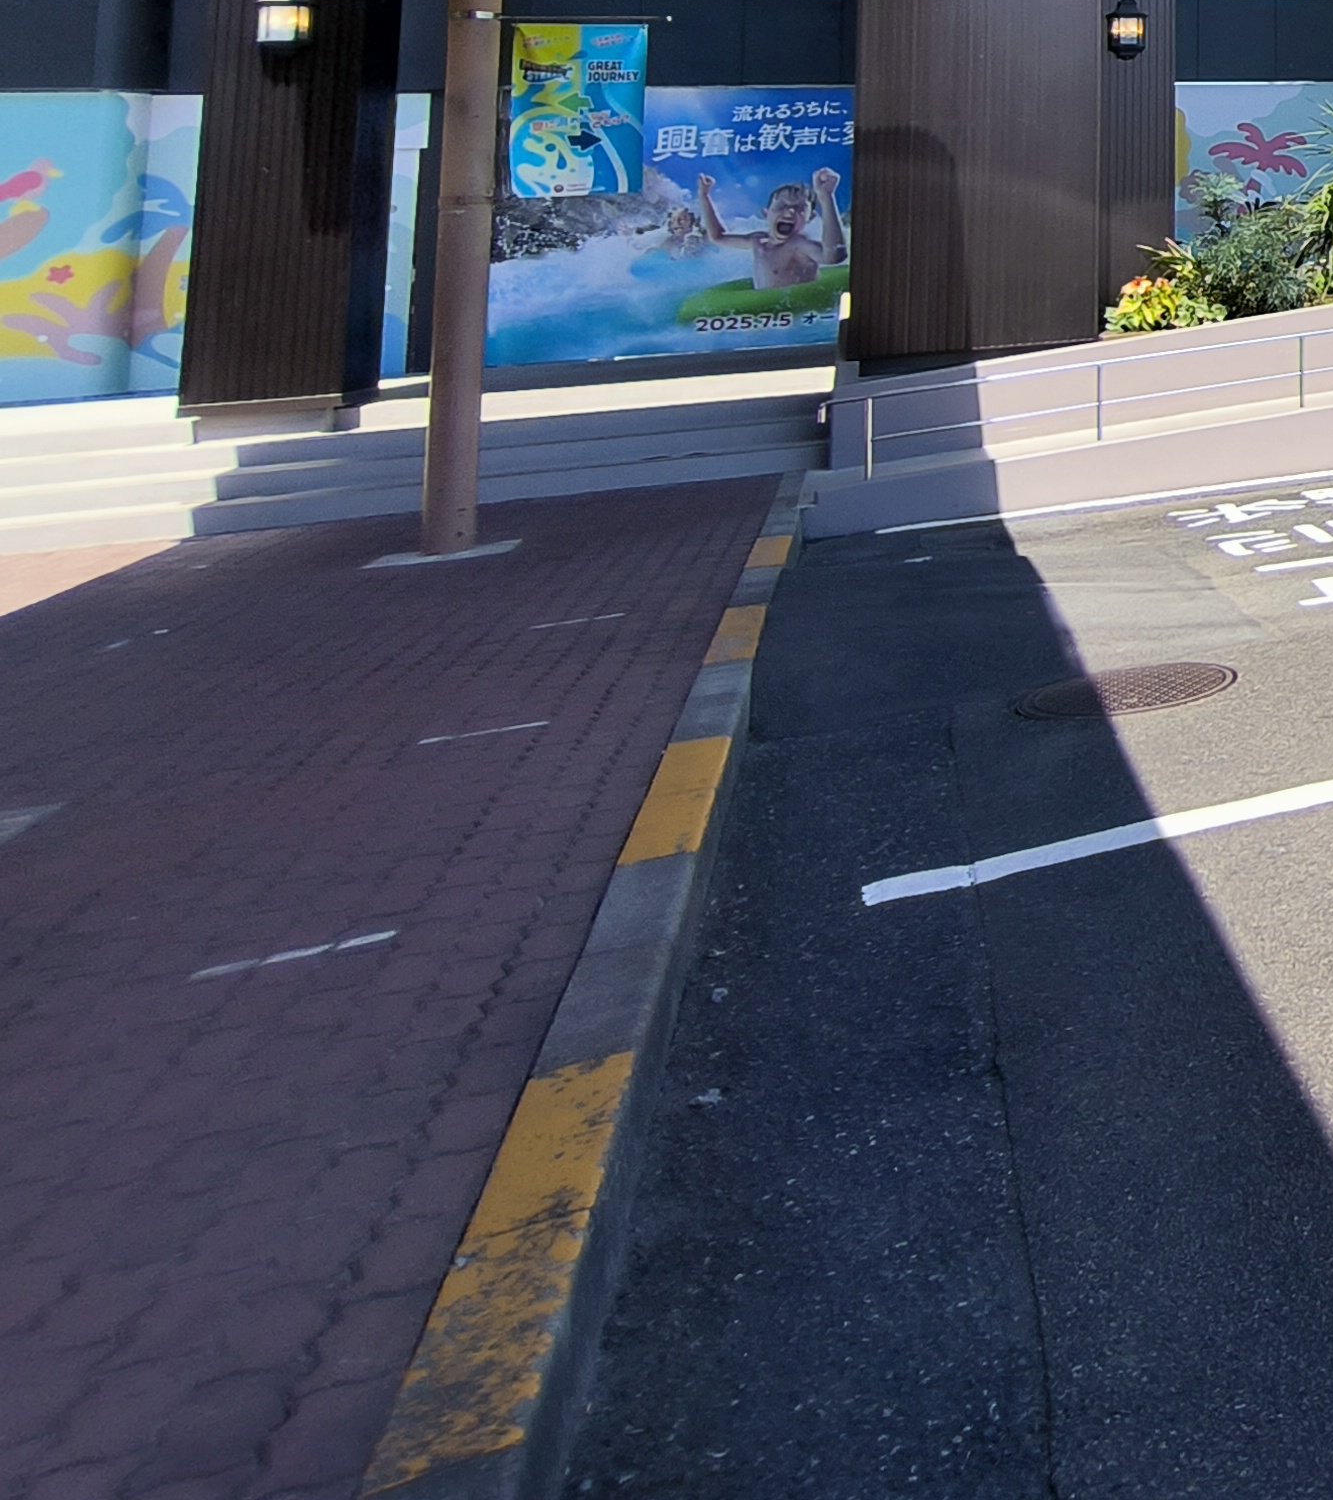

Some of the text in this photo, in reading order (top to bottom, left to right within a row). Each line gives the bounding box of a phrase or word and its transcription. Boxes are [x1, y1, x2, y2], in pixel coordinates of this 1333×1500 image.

[587, 60, 624, 72] GREAT
[586, 71, 640, 82] JOURNEY
[731, 100, 848, 123] 流れるうちに、
[695, 313, 792, 332] 2025.7.5
